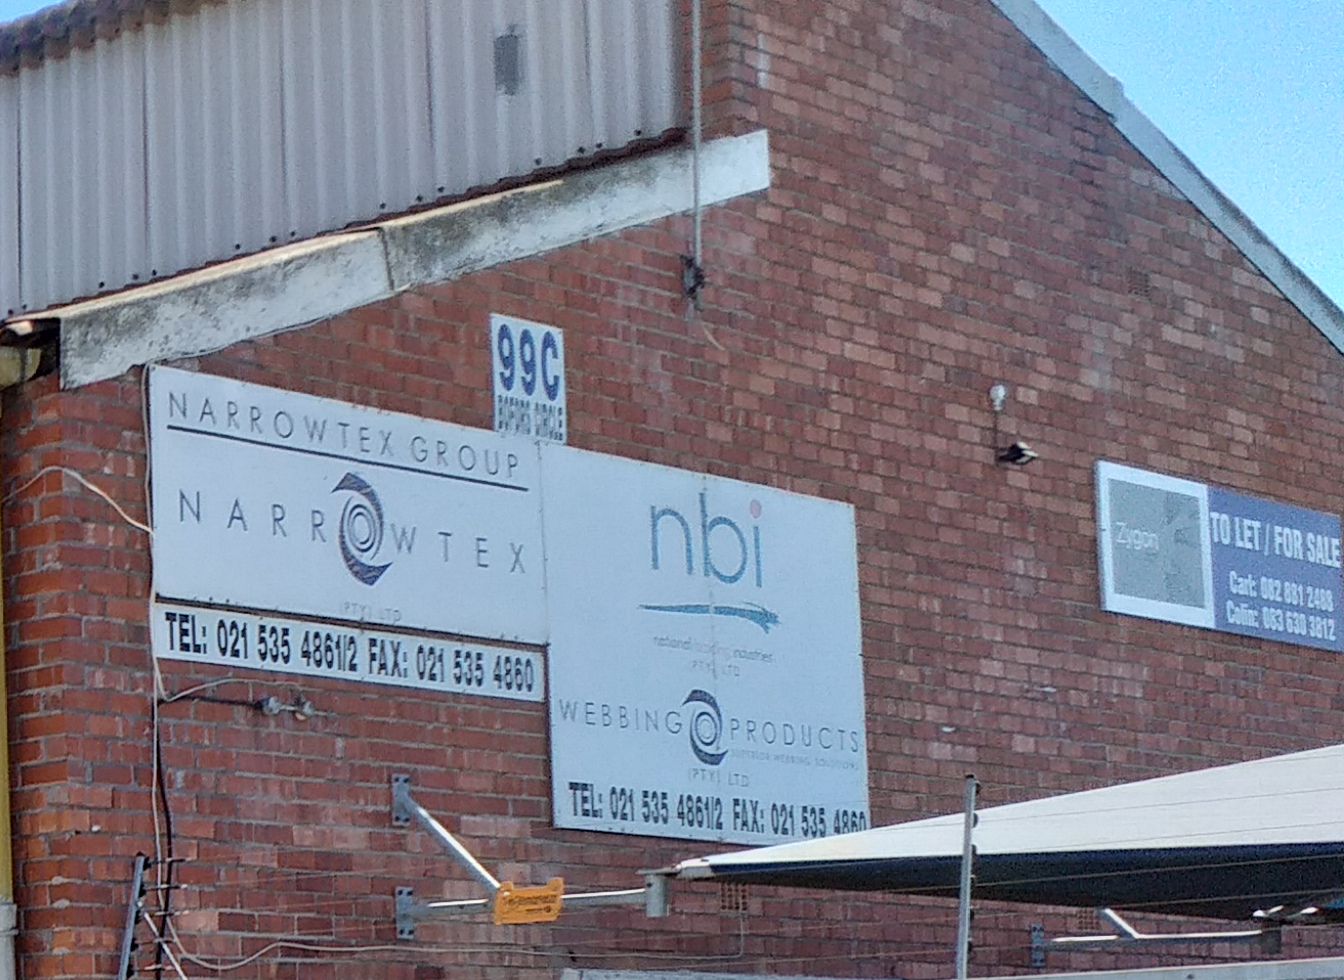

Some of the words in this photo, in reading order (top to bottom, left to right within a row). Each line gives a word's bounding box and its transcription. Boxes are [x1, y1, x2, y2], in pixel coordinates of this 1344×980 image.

[498, 323, 560, 402] 99C
[168, 391, 394, 457] NARROWTEX
[410, 436, 519, 478] GROUP
[534, 401, 564, 441] CIRCLE
[650, 491, 762, 588] nbi
[1210, 511, 1231, 546] TO
[1234, 516, 1261, 551] LET
[1274, 525, 1305, 560] FOR
[1306, 532, 1341, 569] SALE
[165, 612, 207, 654] TEL:
[217, 619, 248, 659] 021
[257, 624, 291, 664] 535
[301, 630, 358, 672] 4861/2
[368, 637, 408, 679] FAX:
[416, 644, 445, 682] 021
[453, 650, 484, 687] 535
[493, 655, 534, 692] 4860
[559, 699, 682, 735] WEBBING
[730, 718, 860, 753] PRODUCTS
[727, 772, 750, 788] LTD
[569, 781, 603, 819] TEL:
[610, 786, 634, 822] 021
[642, 790, 669, 825] 535
[733, 798, 765, 834] FAX:
[770, 803, 795, 836] 021
[801, 805, 826, 838] 535
[833, 809, 867, 834] 4860
